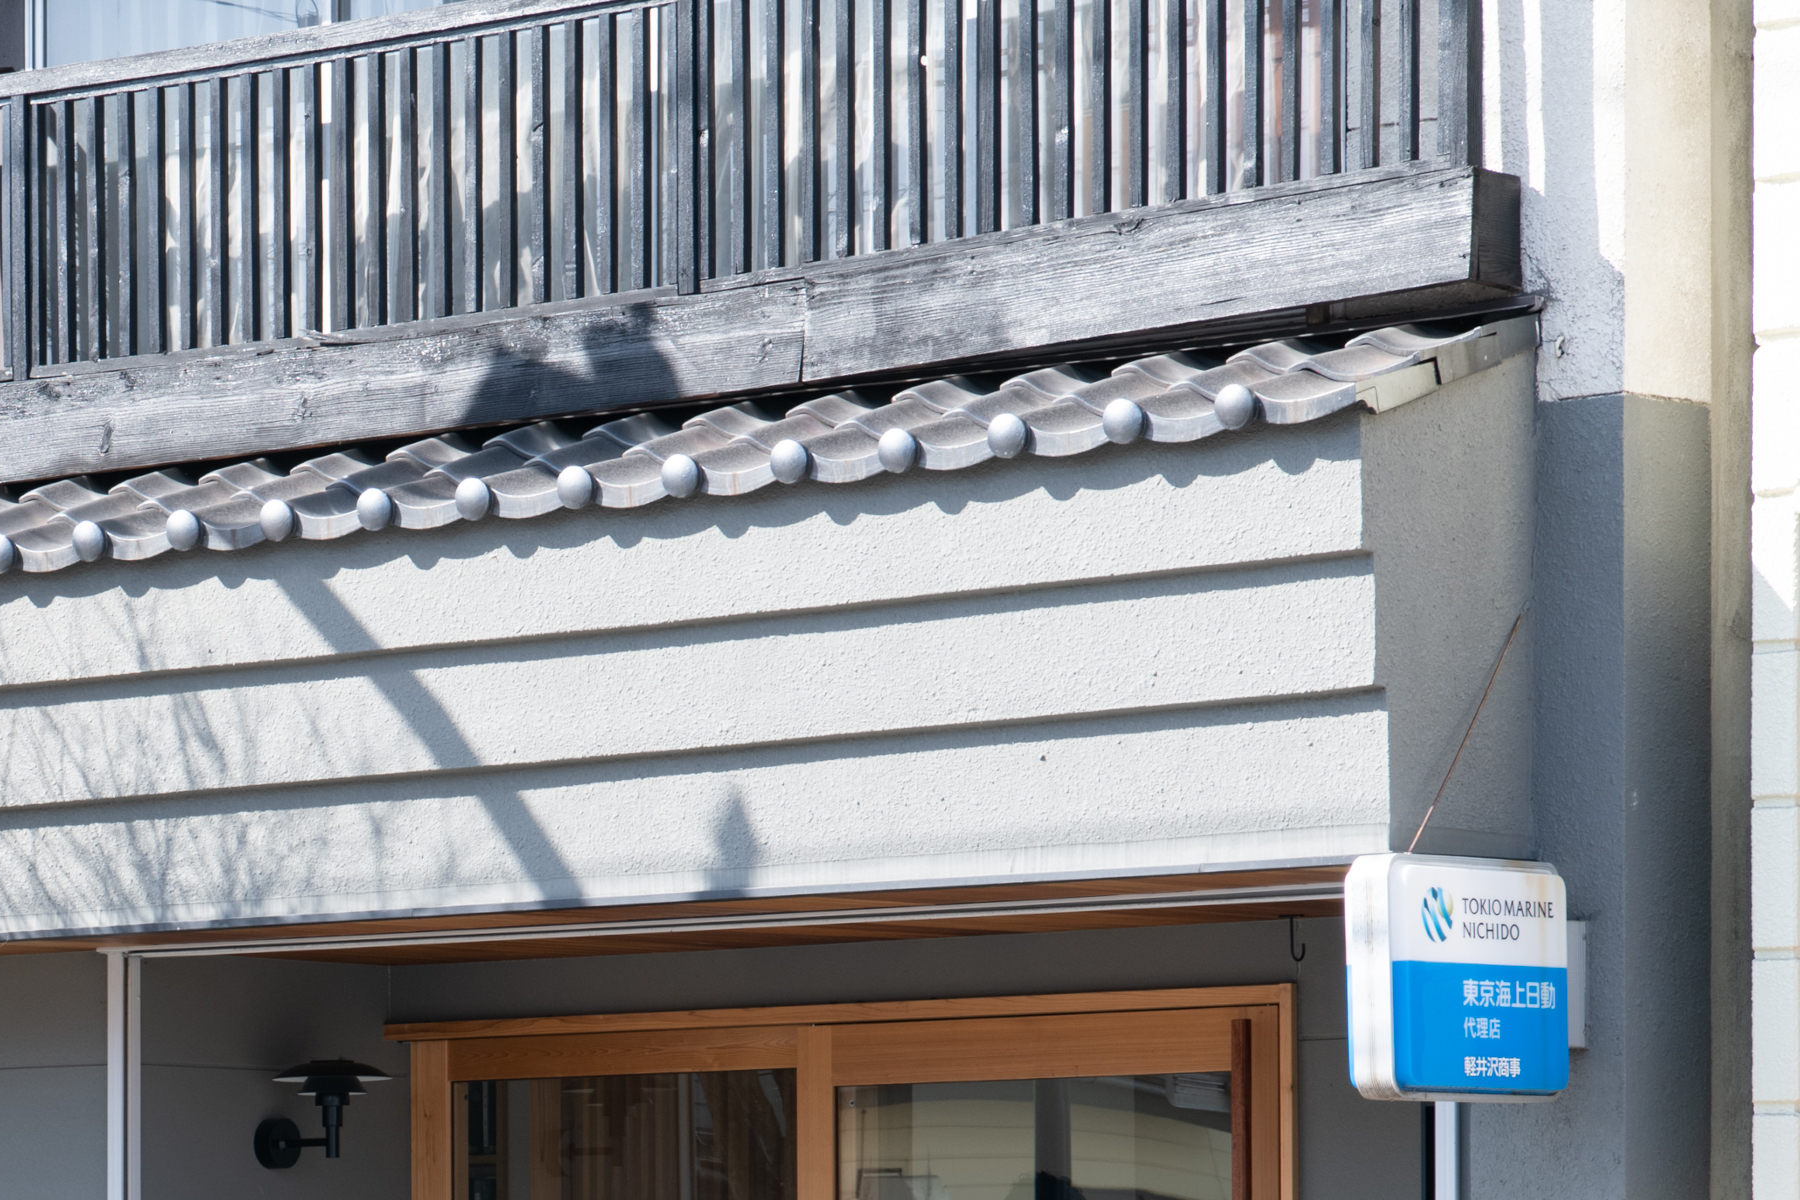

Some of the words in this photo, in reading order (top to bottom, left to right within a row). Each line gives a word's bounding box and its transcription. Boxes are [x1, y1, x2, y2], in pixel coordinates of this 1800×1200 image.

[1462, 897, 1502, 916] TOKIO
[1503, 900, 1554, 919] MARINE
[1462, 922, 1520, 941] NICHIDO
[1462, 978, 1556, 1010] 東京海上日動
[1463, 1016, 1501, 1039] 代理店
[1464, 1056, 1521, 1078] 軽井沢商事
